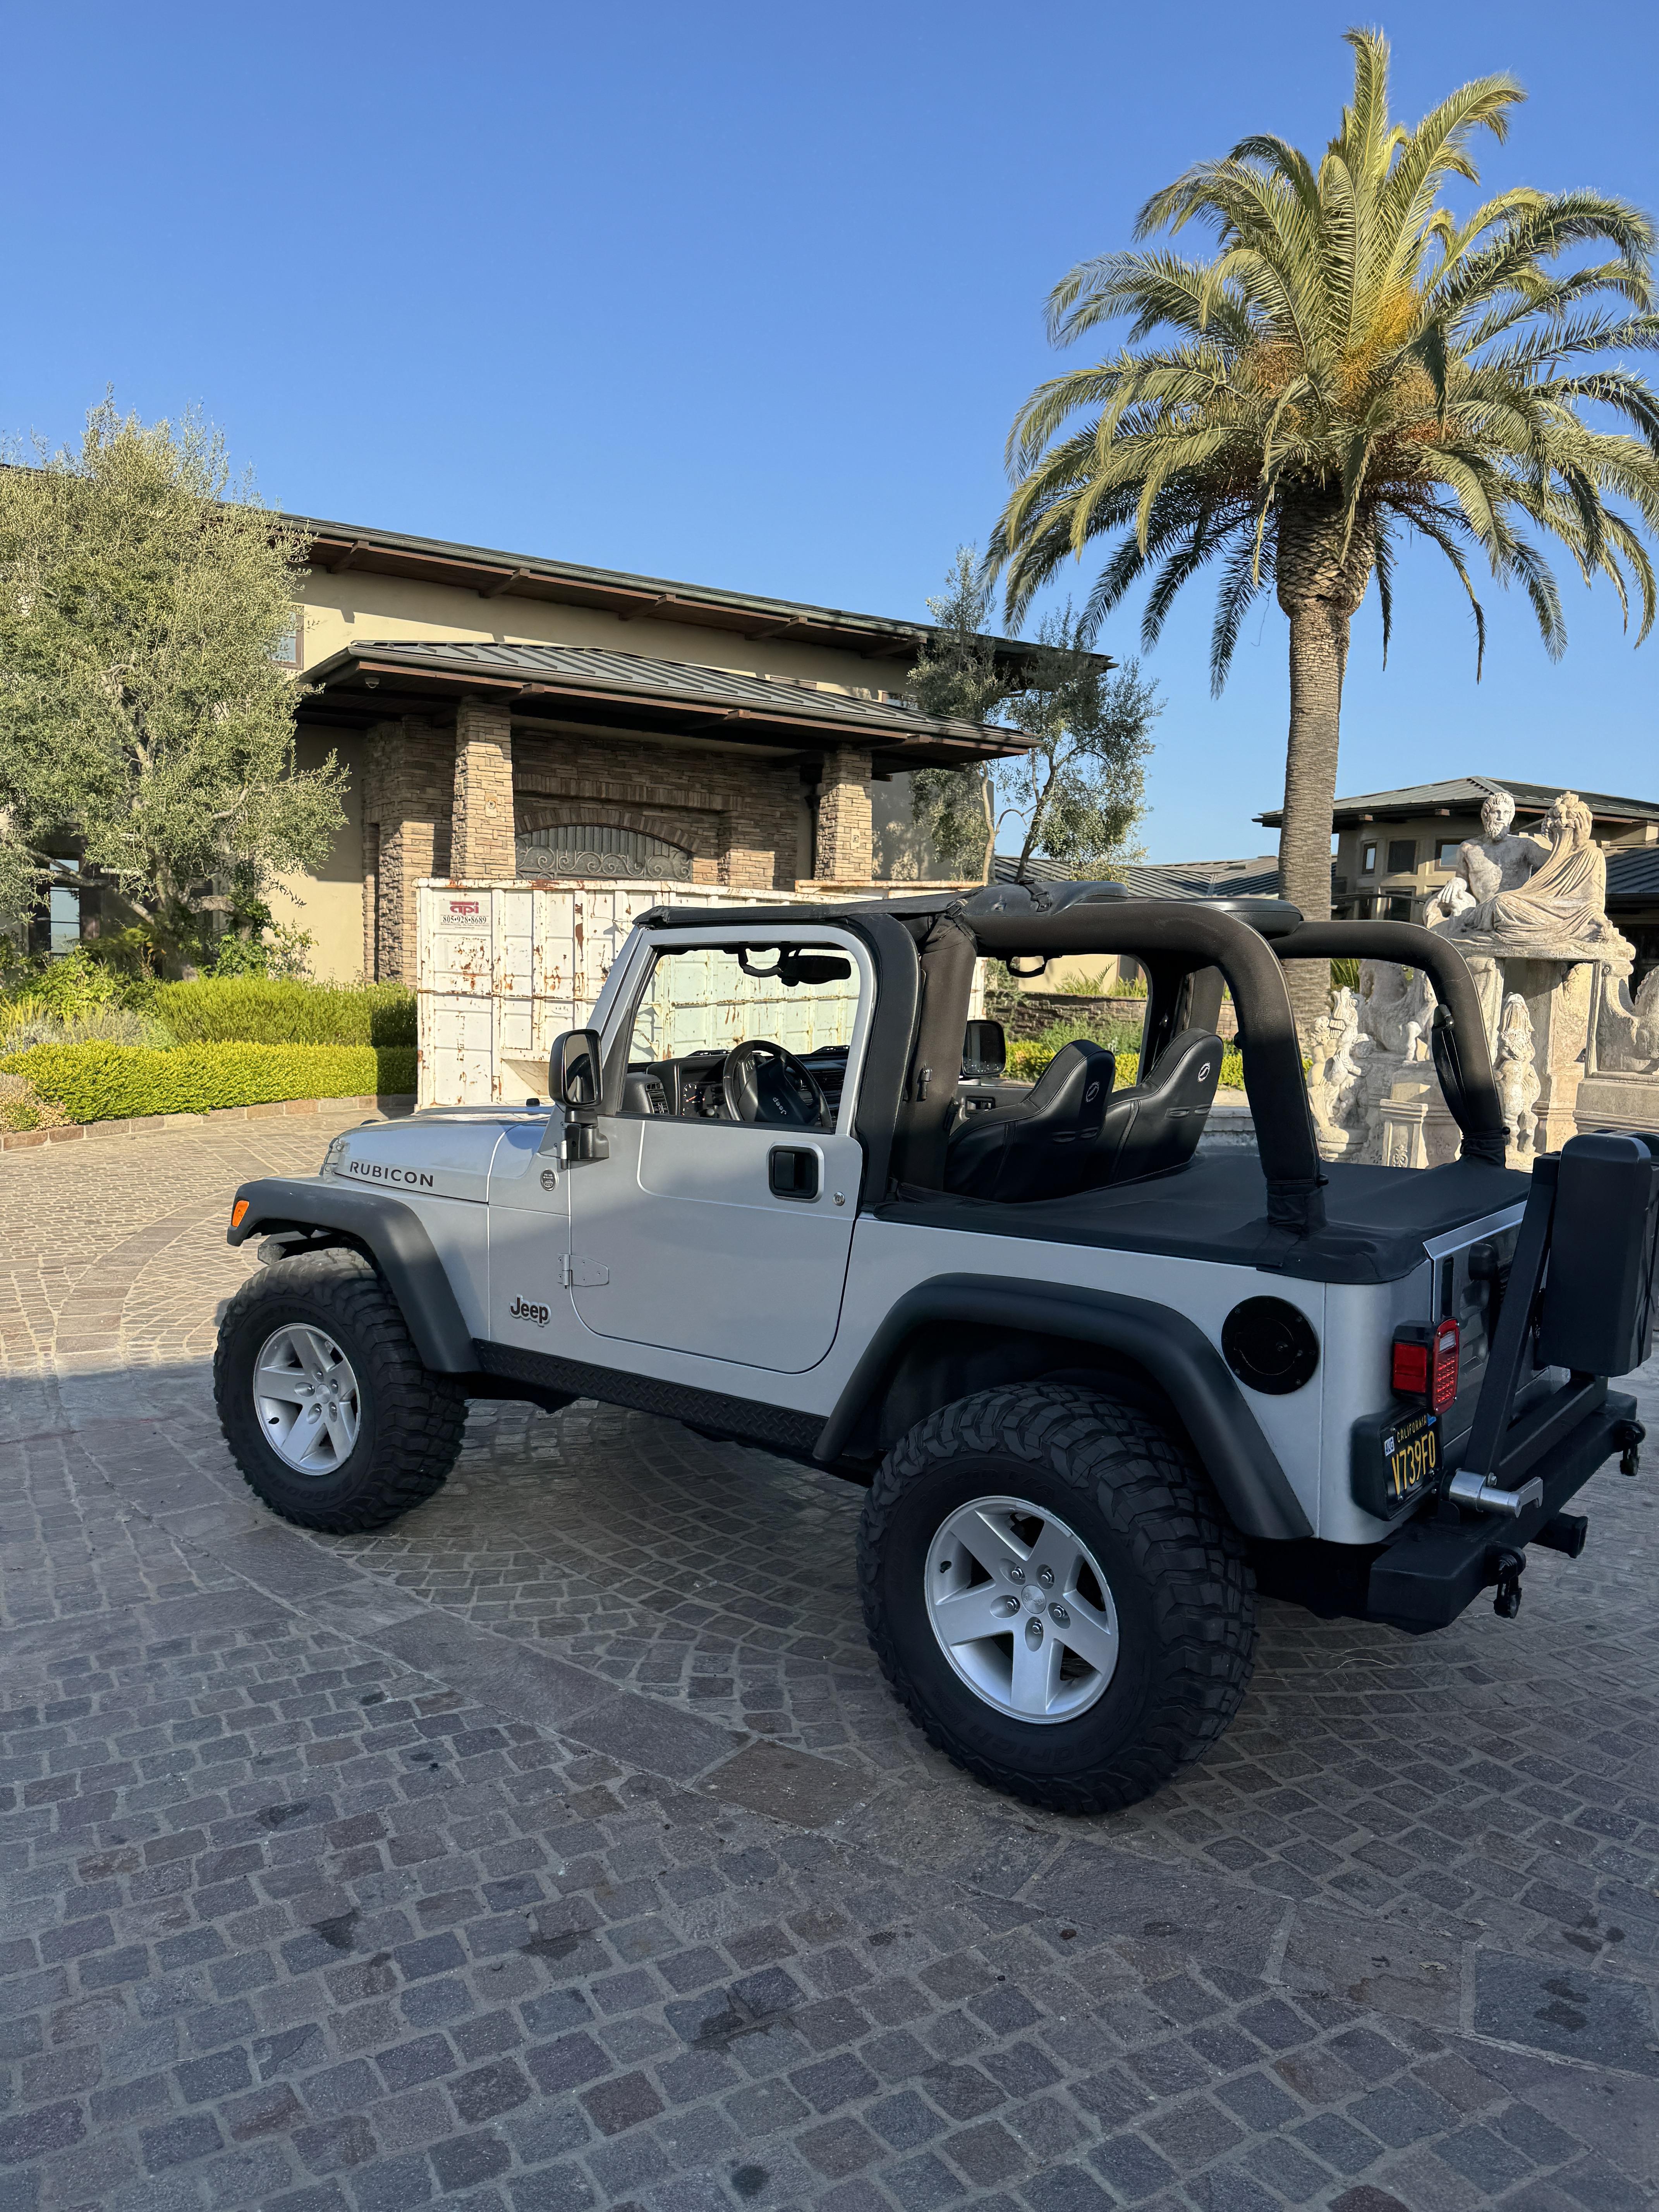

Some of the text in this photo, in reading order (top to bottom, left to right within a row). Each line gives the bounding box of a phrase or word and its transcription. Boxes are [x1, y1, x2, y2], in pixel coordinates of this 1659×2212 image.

[773, 1097, 787, 1115] Jeep
[350, 1161, 433, 1187] RUBICON
[510, 1296, 550, 1325] Jeep
[1397, 1415, 1427, 1443] CALIFORNIA
[1386, 1438, 1394, 1454] AUG
